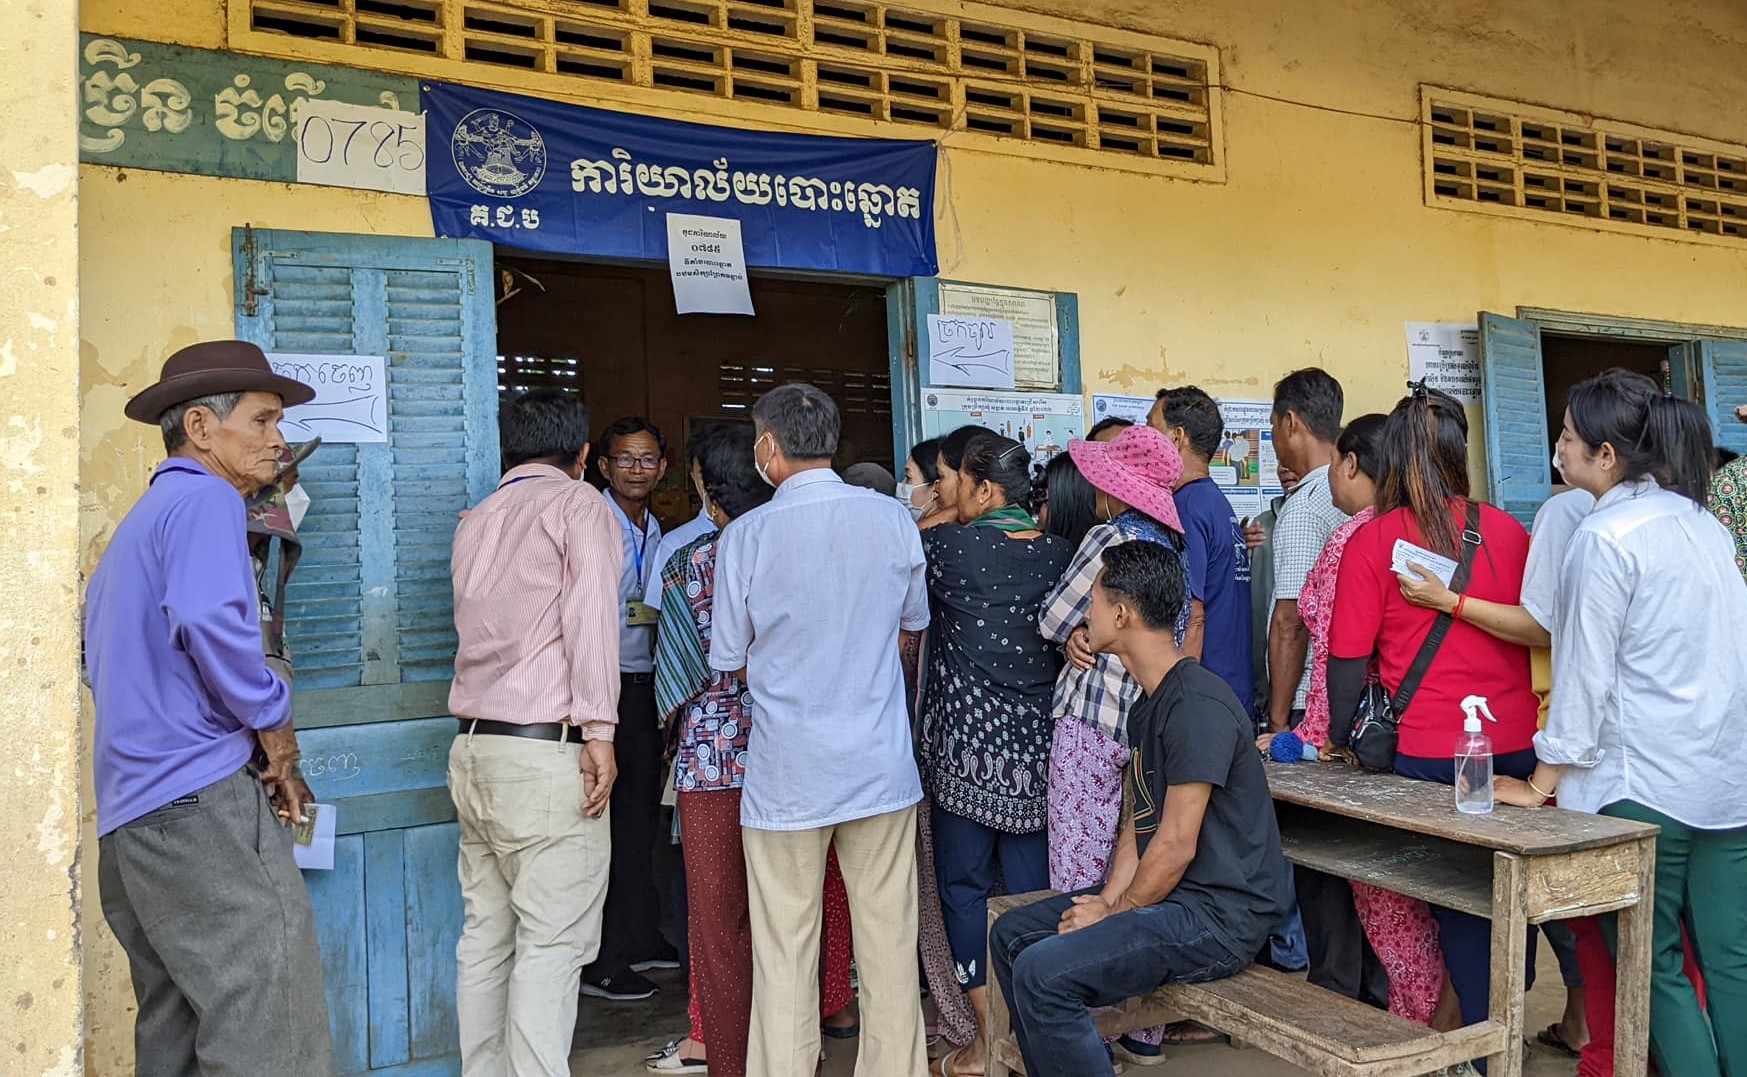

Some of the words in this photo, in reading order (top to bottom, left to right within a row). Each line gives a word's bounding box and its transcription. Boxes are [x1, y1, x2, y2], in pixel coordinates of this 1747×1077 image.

[300, 115, 425, 171] 0785
[570, 148, 921, 229] ការិយាល័យបោះឆ្នោត
[470, 204, 540, 230] គ.ជ.ប
[937, 319, 996, 351] ច្រកចូល
